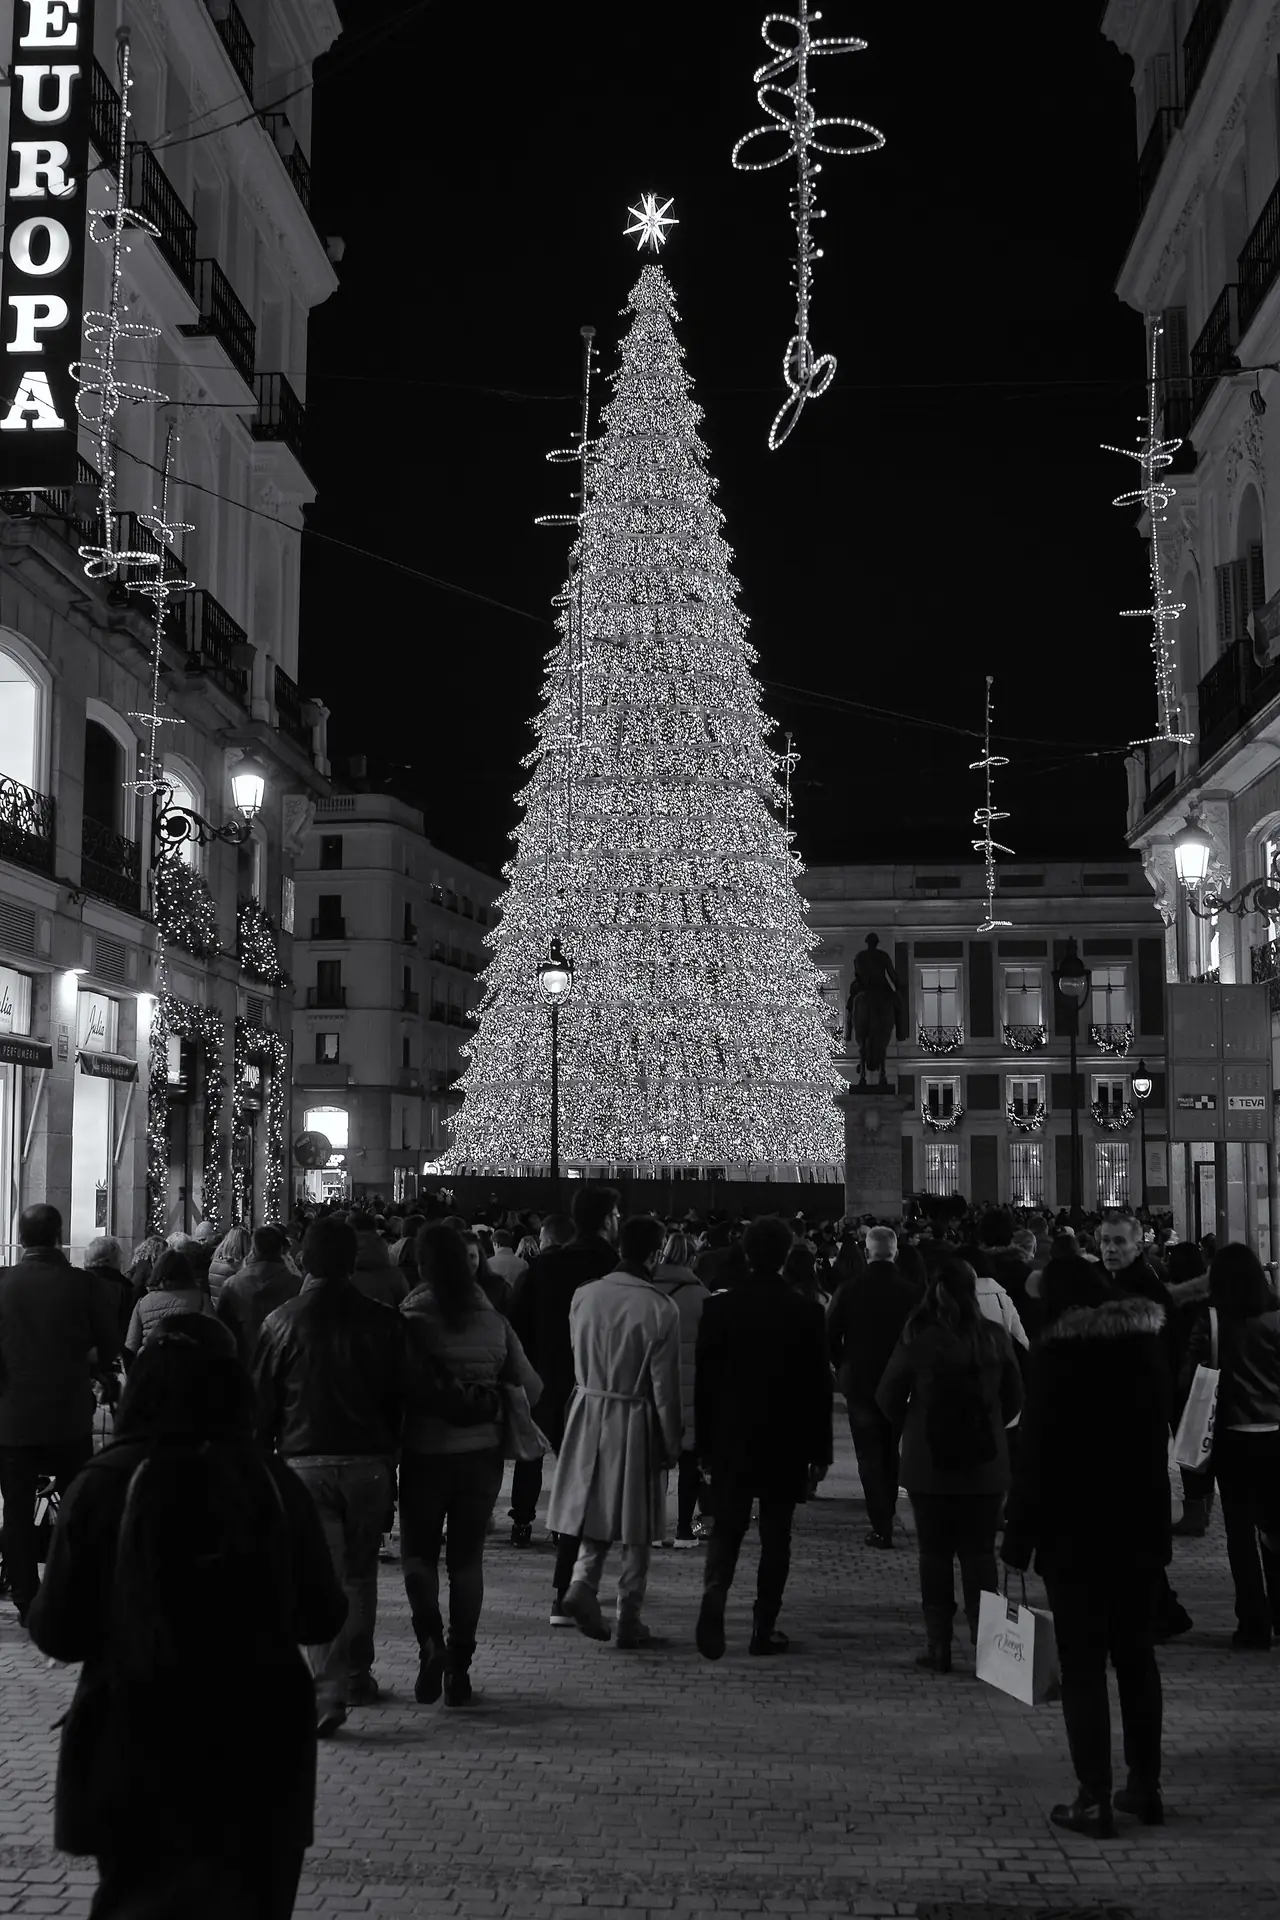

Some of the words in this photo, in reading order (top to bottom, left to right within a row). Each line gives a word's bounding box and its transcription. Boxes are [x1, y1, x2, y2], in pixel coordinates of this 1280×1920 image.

[1, 0, 81, 430] EUROPA
[84, 1005, 105, 1046] Julia
[1239, 1098, 1264, 1107] TEVA
